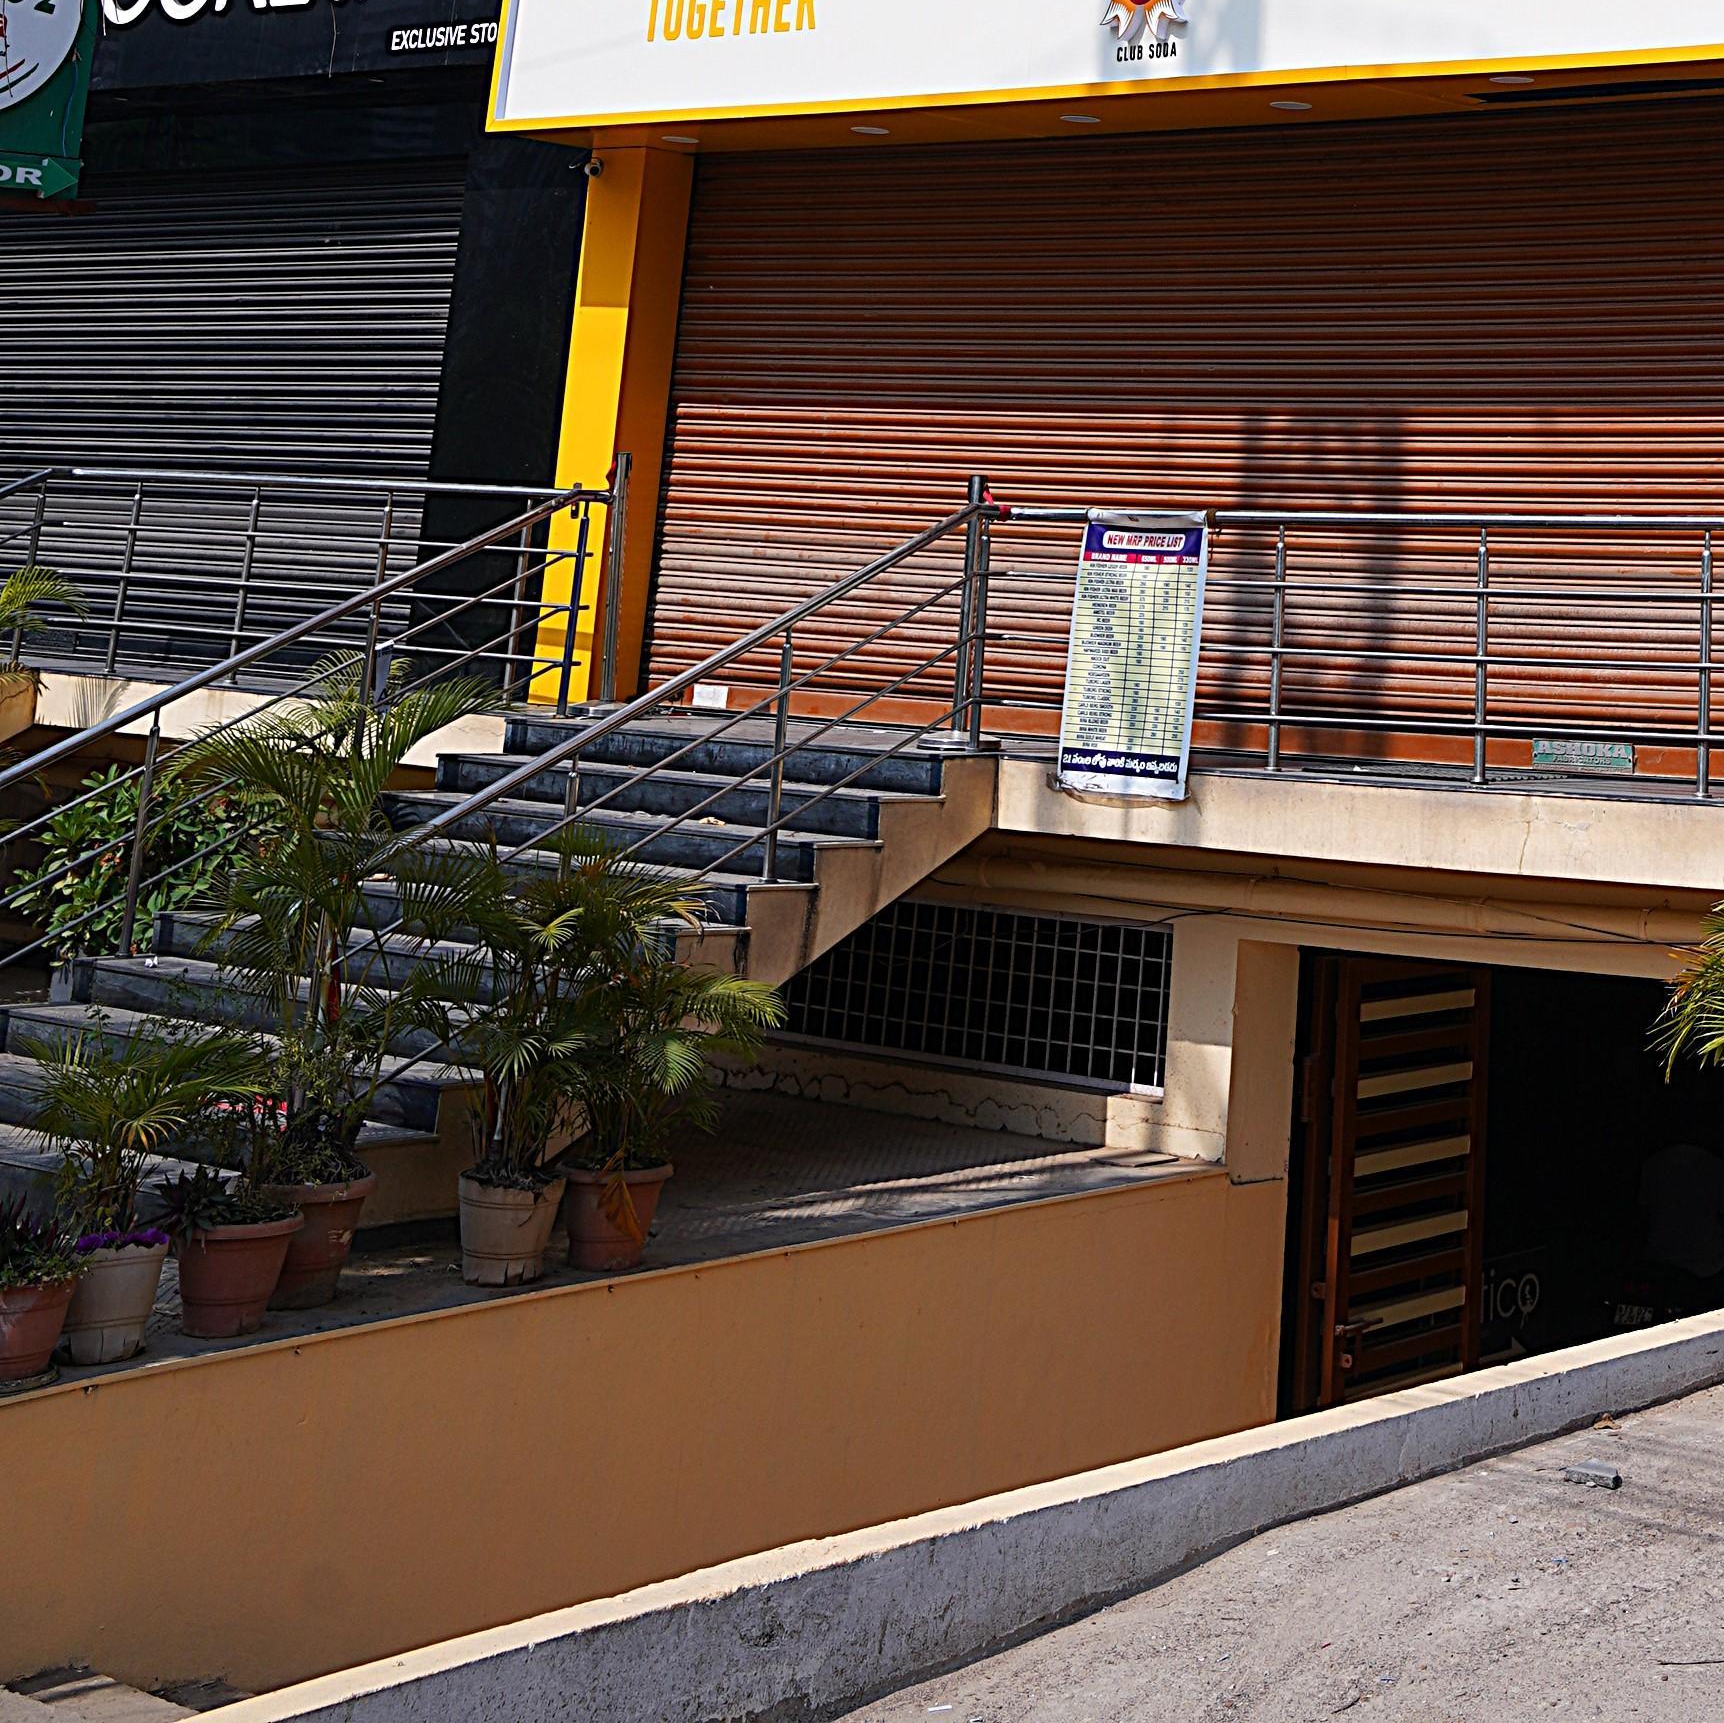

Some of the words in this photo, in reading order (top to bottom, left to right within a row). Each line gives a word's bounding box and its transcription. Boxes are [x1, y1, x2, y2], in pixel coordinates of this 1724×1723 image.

[391, 25, 467, 50] EXCLUSIVE
[470, 22, 498, 44] STO
[1116, 44, 1143, 62] CLUB
[1148, 41, 1177, 59] SODA
[1107, 534, 1124, 545] NEW
[1126, 535, 1143, 546] MRP
[1144, 536, 1166, 547] PRICE
[1167, 537, 1183, 548] LIST
[1536, 740, 1628, 759] ASHOKA
